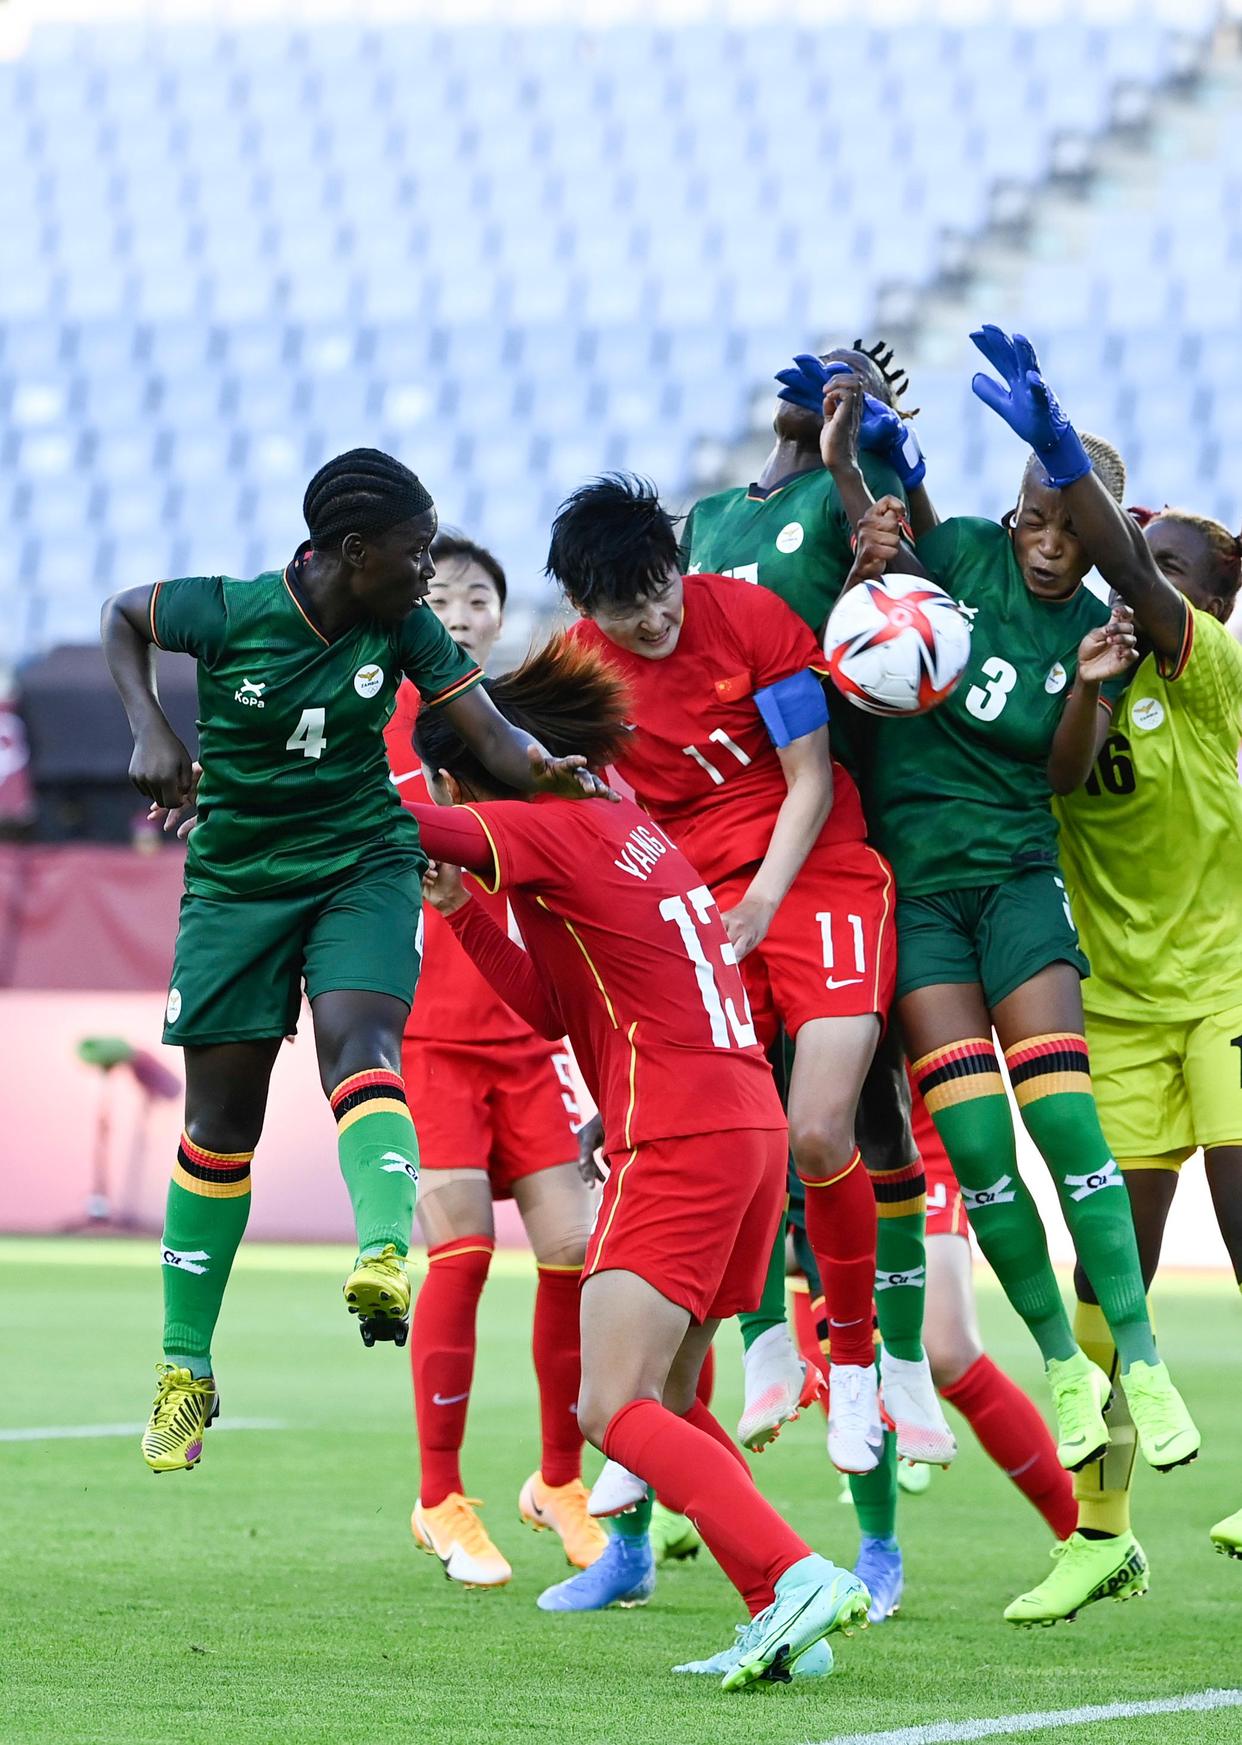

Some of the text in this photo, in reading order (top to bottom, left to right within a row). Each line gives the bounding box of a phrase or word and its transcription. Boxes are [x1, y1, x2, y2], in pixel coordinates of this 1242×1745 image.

[965, 656, 1017, 721] 3
[286, 707, 327, 759] 4
[682, 728, 752, 785] 11
[614, 825, 667, 881] YANG
[658, 884, 758, 1048] 13
[815, 912, 866, 973] 11
[975, 1192, 995, 1204] Cu
[1086, 1175, 1107, 1188] Cu
[888, 1274, 909, 1285] Cu
